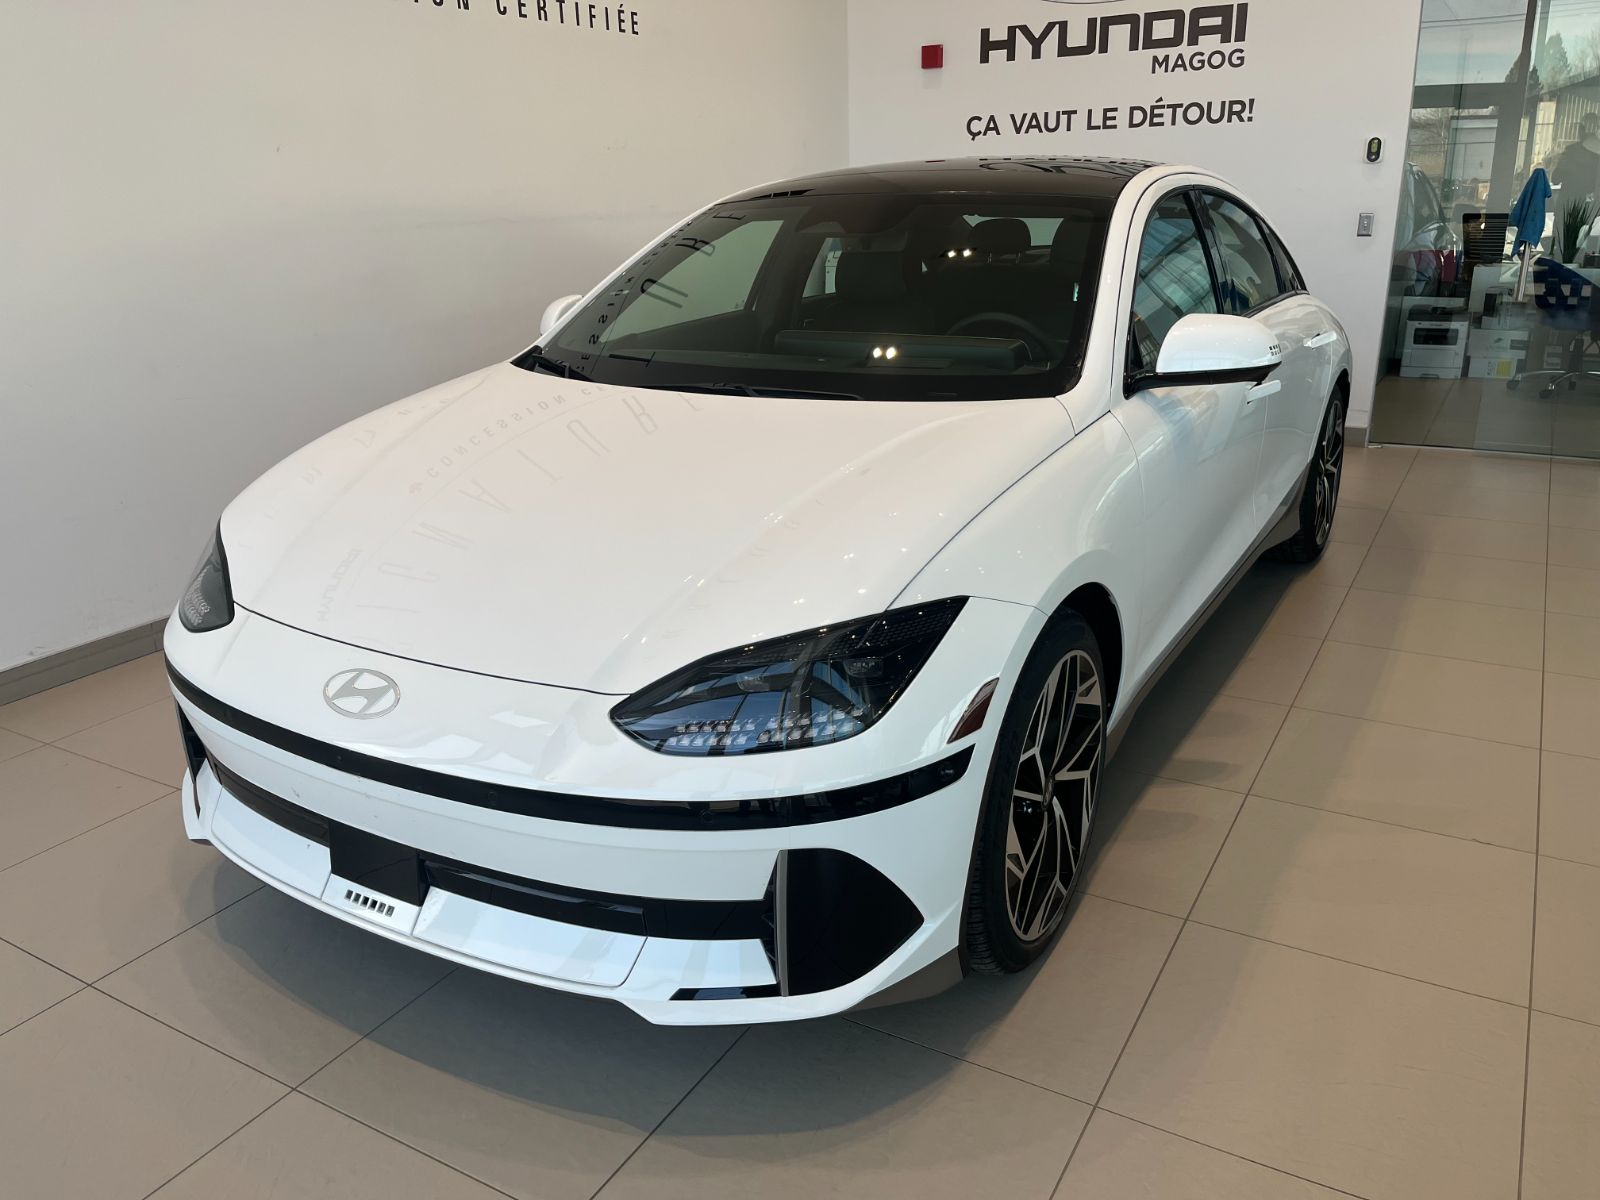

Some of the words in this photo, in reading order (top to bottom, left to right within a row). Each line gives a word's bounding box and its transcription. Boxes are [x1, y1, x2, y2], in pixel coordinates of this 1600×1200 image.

[496, 0, 640, 36] CERTIFIÉE
[979, 2, 1249, 64] HYUNDAI
[1151, 48, 1246, 74] MAGOG
[966, 115, 1001, 141] ÇA
[1010, 110, 1077, 135] VAUT
[1086, 107, 1118, 131] LE
[1128, 96, 1255, 129] DÉTOUR!
